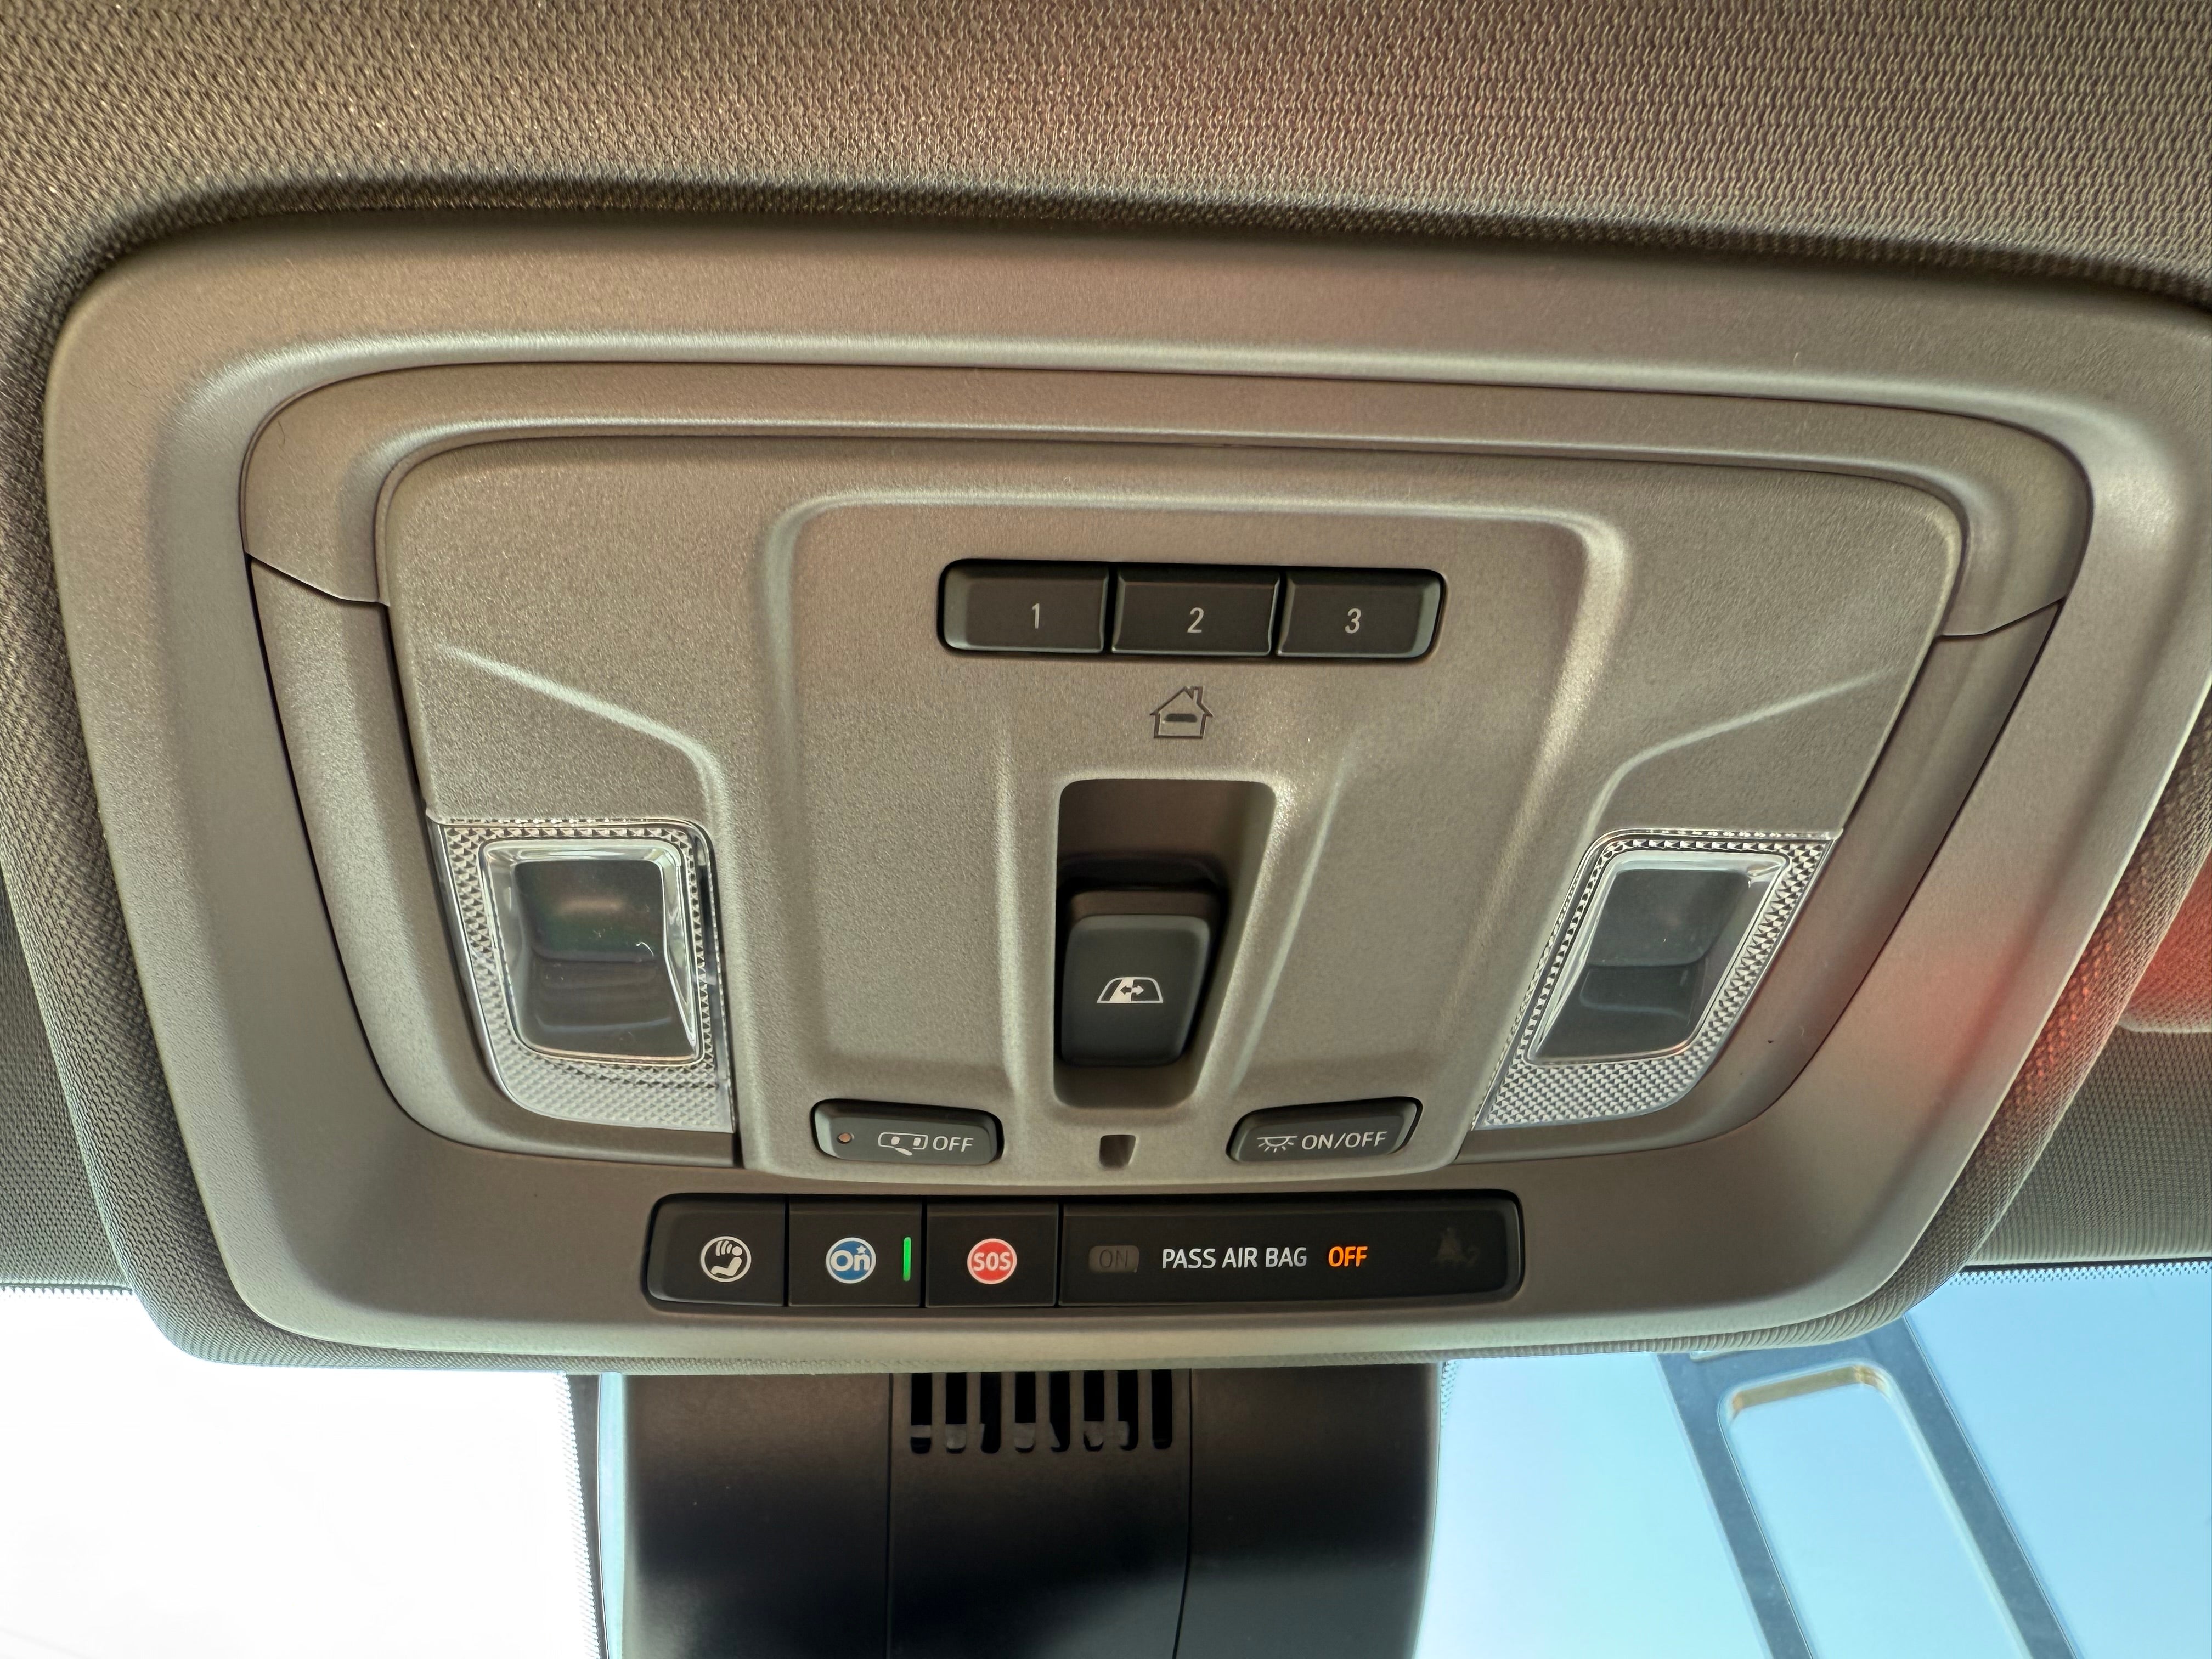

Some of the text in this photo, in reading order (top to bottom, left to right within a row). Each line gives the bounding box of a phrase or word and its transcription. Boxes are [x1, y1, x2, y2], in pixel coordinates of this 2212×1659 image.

[1031, 603, 1040, 629] 1
[1187, 607, 1204, 633] 2
[1345, 608, 1362, 634] 3
[932, 1136, 974, 1152] OFF
[1301, 1131, 1387, 1150] ON/OFF
[831, 1246, 871, 1272] On
[973, 1251, 1011, 1271] SOS
[1099, 1249, 1128, 1269] ON
[1162, 1246, 1368, 1268] PASS AIR BAG OFF
